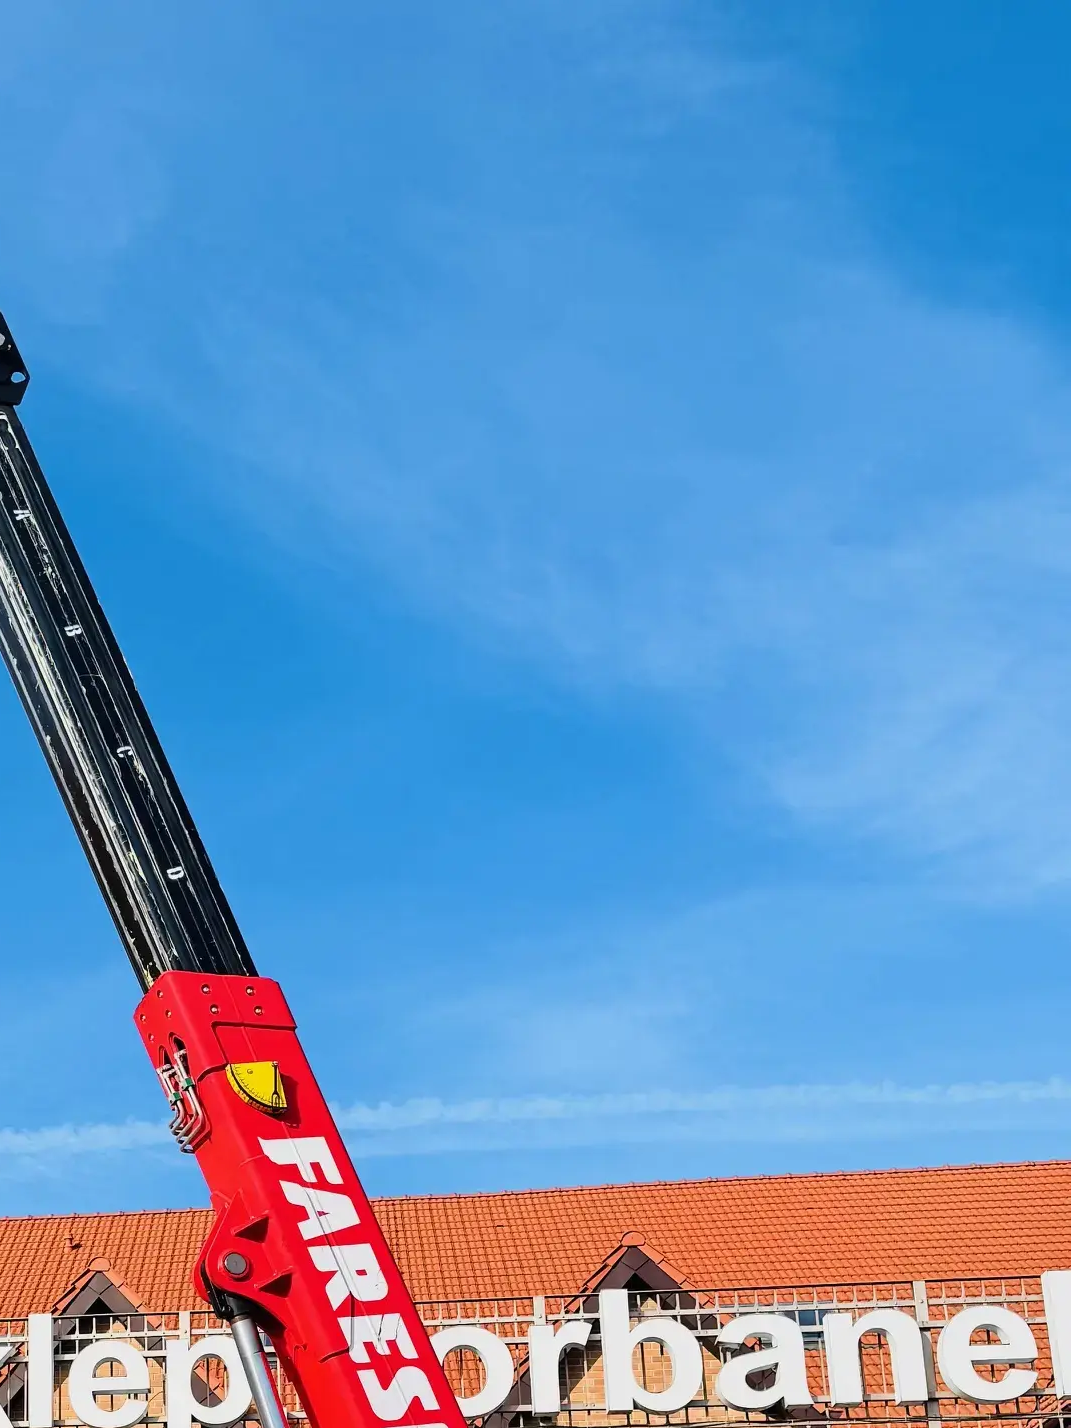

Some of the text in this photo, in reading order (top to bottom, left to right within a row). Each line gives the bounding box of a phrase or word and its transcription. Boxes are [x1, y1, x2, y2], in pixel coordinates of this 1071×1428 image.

[64, 624, 82, 637] B
[116, 745, 134, 758] C
[166, 866, 184, 880] D
